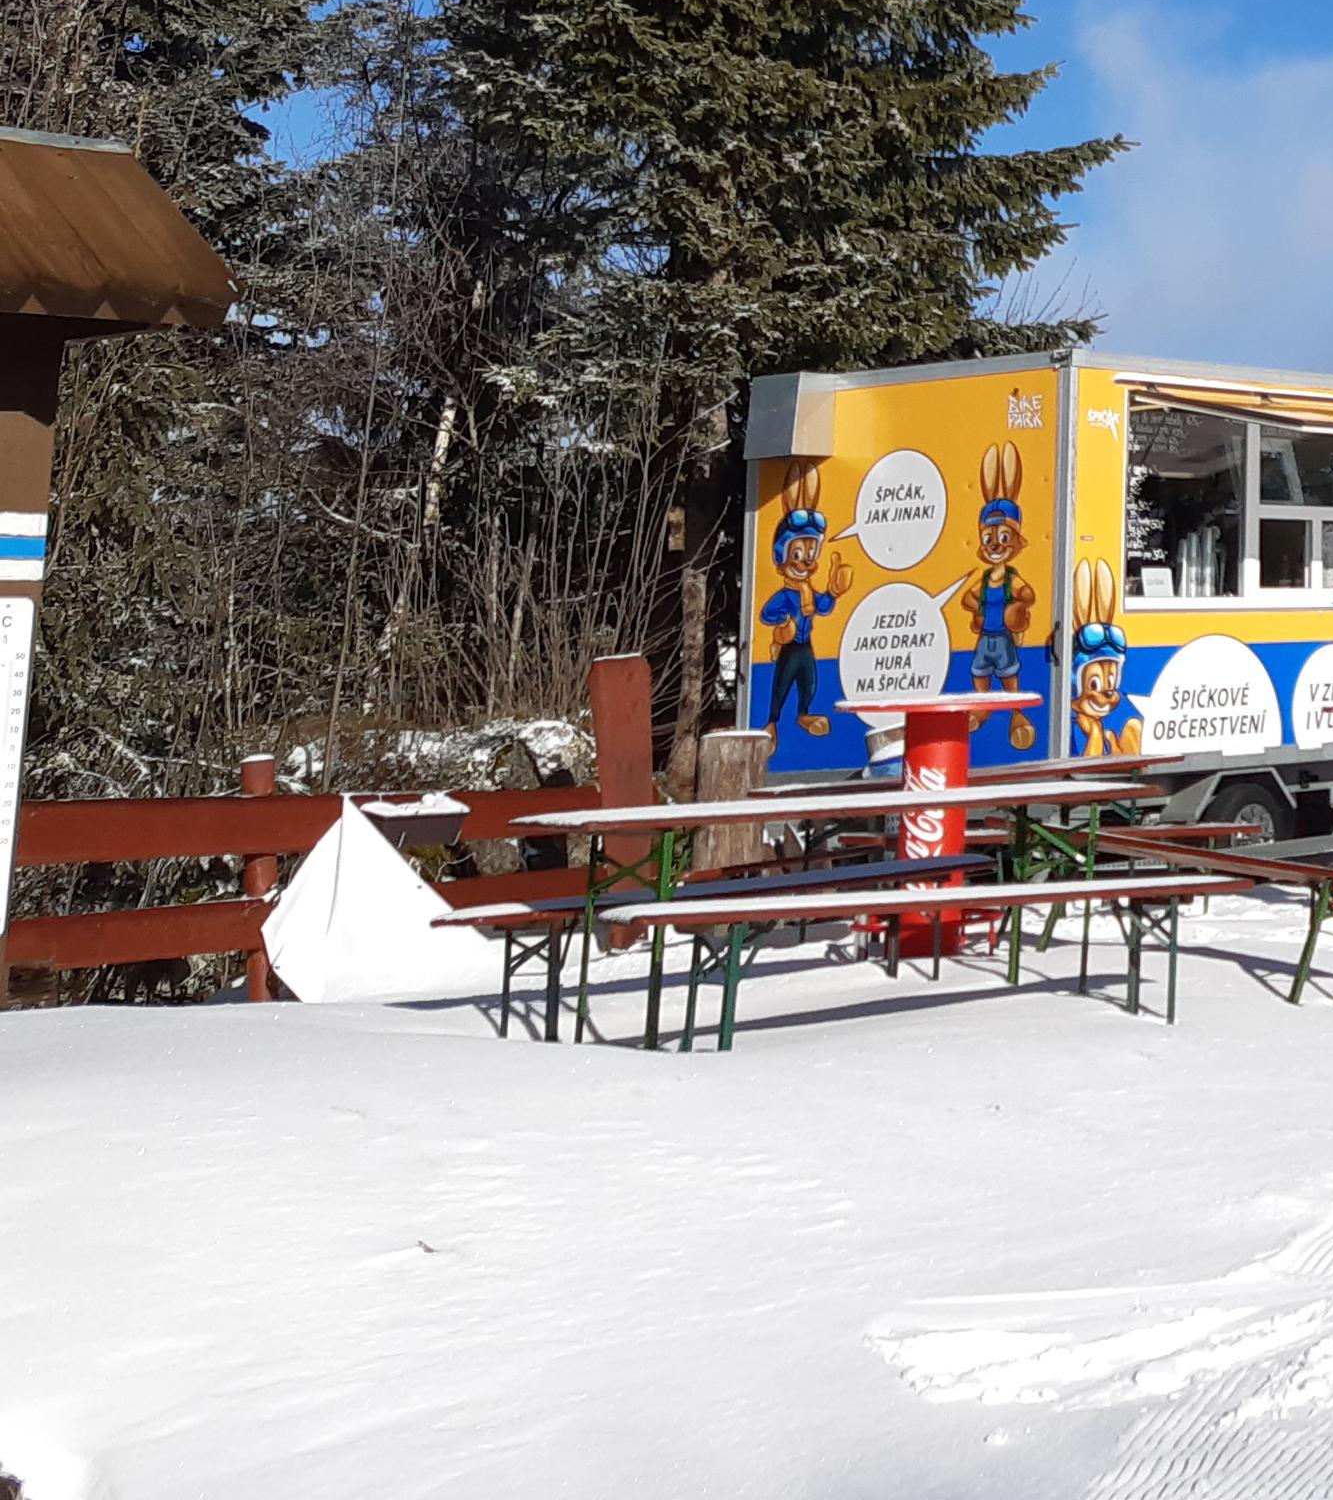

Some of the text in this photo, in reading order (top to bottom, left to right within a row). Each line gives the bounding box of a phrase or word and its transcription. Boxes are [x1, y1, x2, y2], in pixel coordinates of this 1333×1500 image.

[875, 483, 926, 503] ŠPIČÁK,
[864, 504, 936, 525] JAK JINAK!
[871, 609, 917, 630] JEZDÍŠ
[853, 632, 935, 652] JAKO DRAK?
[874, 651, 912, 671] HURÁ
[856, 672, 931, 693] NA ŠPIČÁK!
[1310, 683, 1320, 702] V
[1170, 682, 1250, 710] ŠPIČKOVÉ
[1153, 709, 1267, 741] OBČERSTVENÍ
